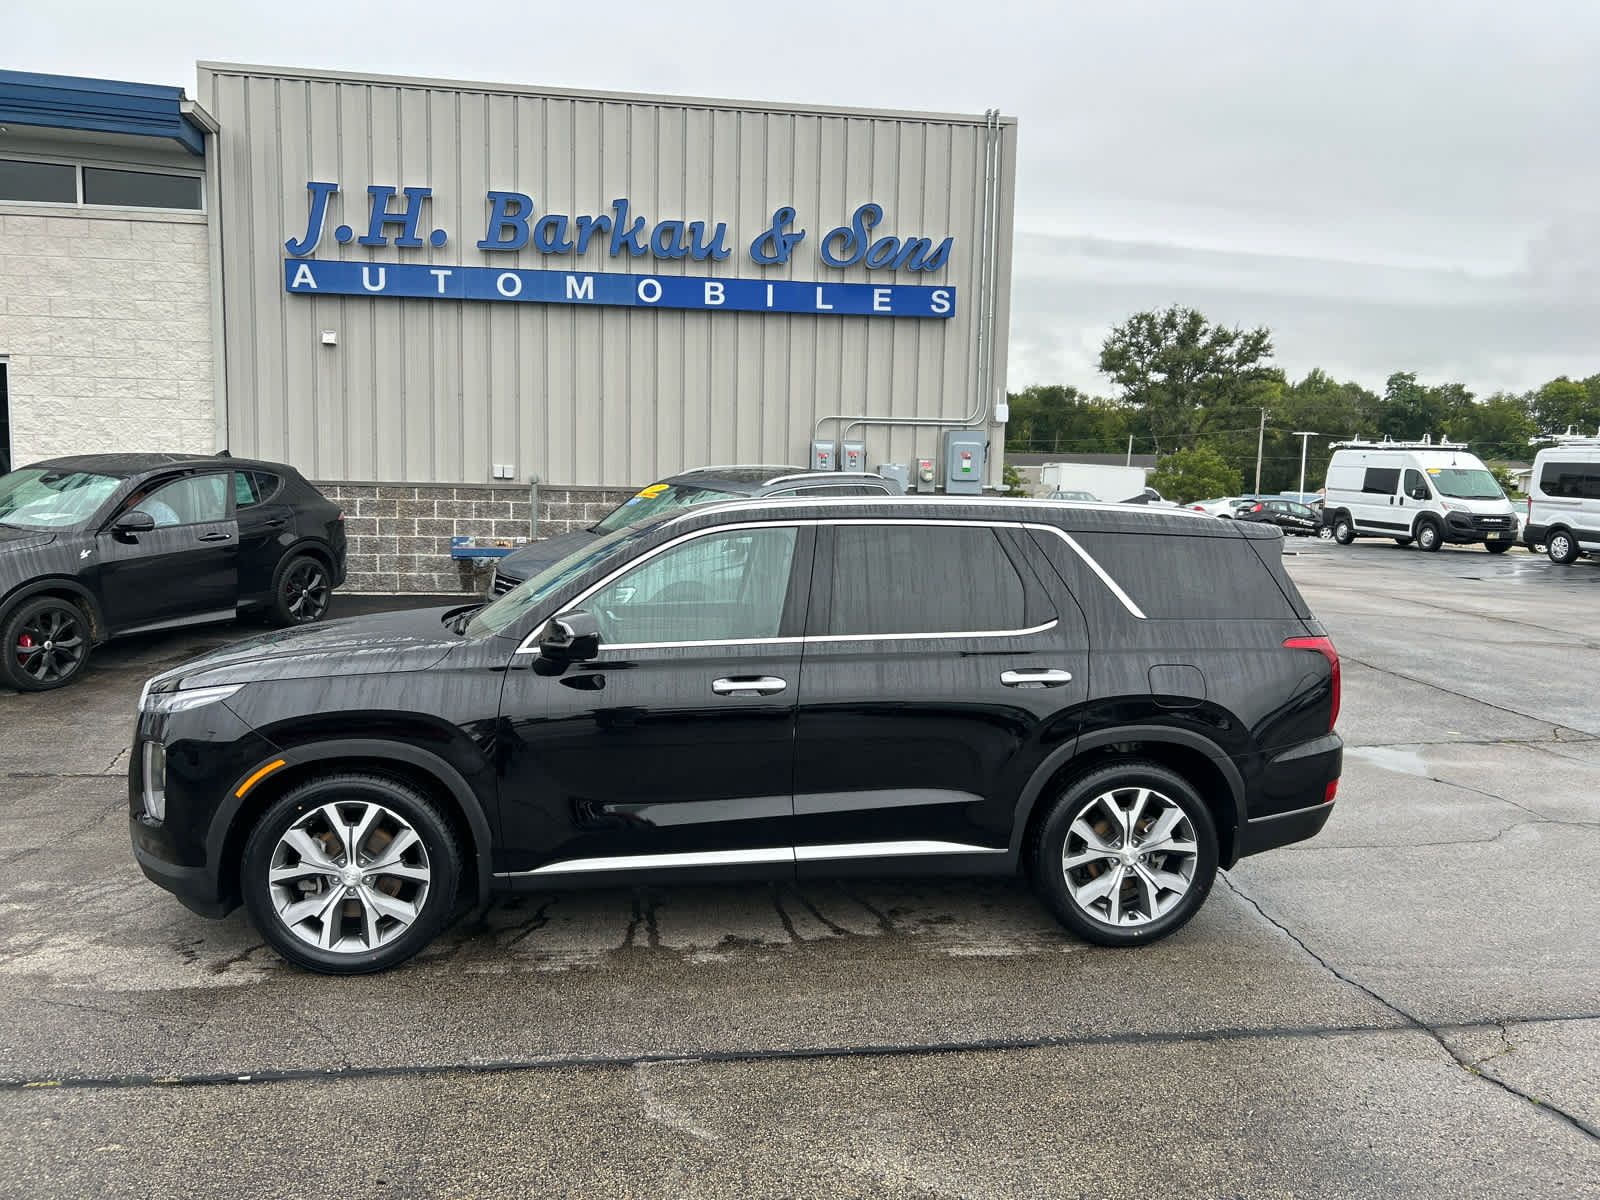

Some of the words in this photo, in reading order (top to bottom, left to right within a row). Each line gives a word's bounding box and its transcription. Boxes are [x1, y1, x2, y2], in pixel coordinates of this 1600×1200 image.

[285, 182, 448, 256] J.H.
[477, 190, 731, 262] Barkau
[750, 206, 806, 264] &
[821, 203, 954, 272] Sons
[291, 263, 951, 314] AUTOMOBILES
